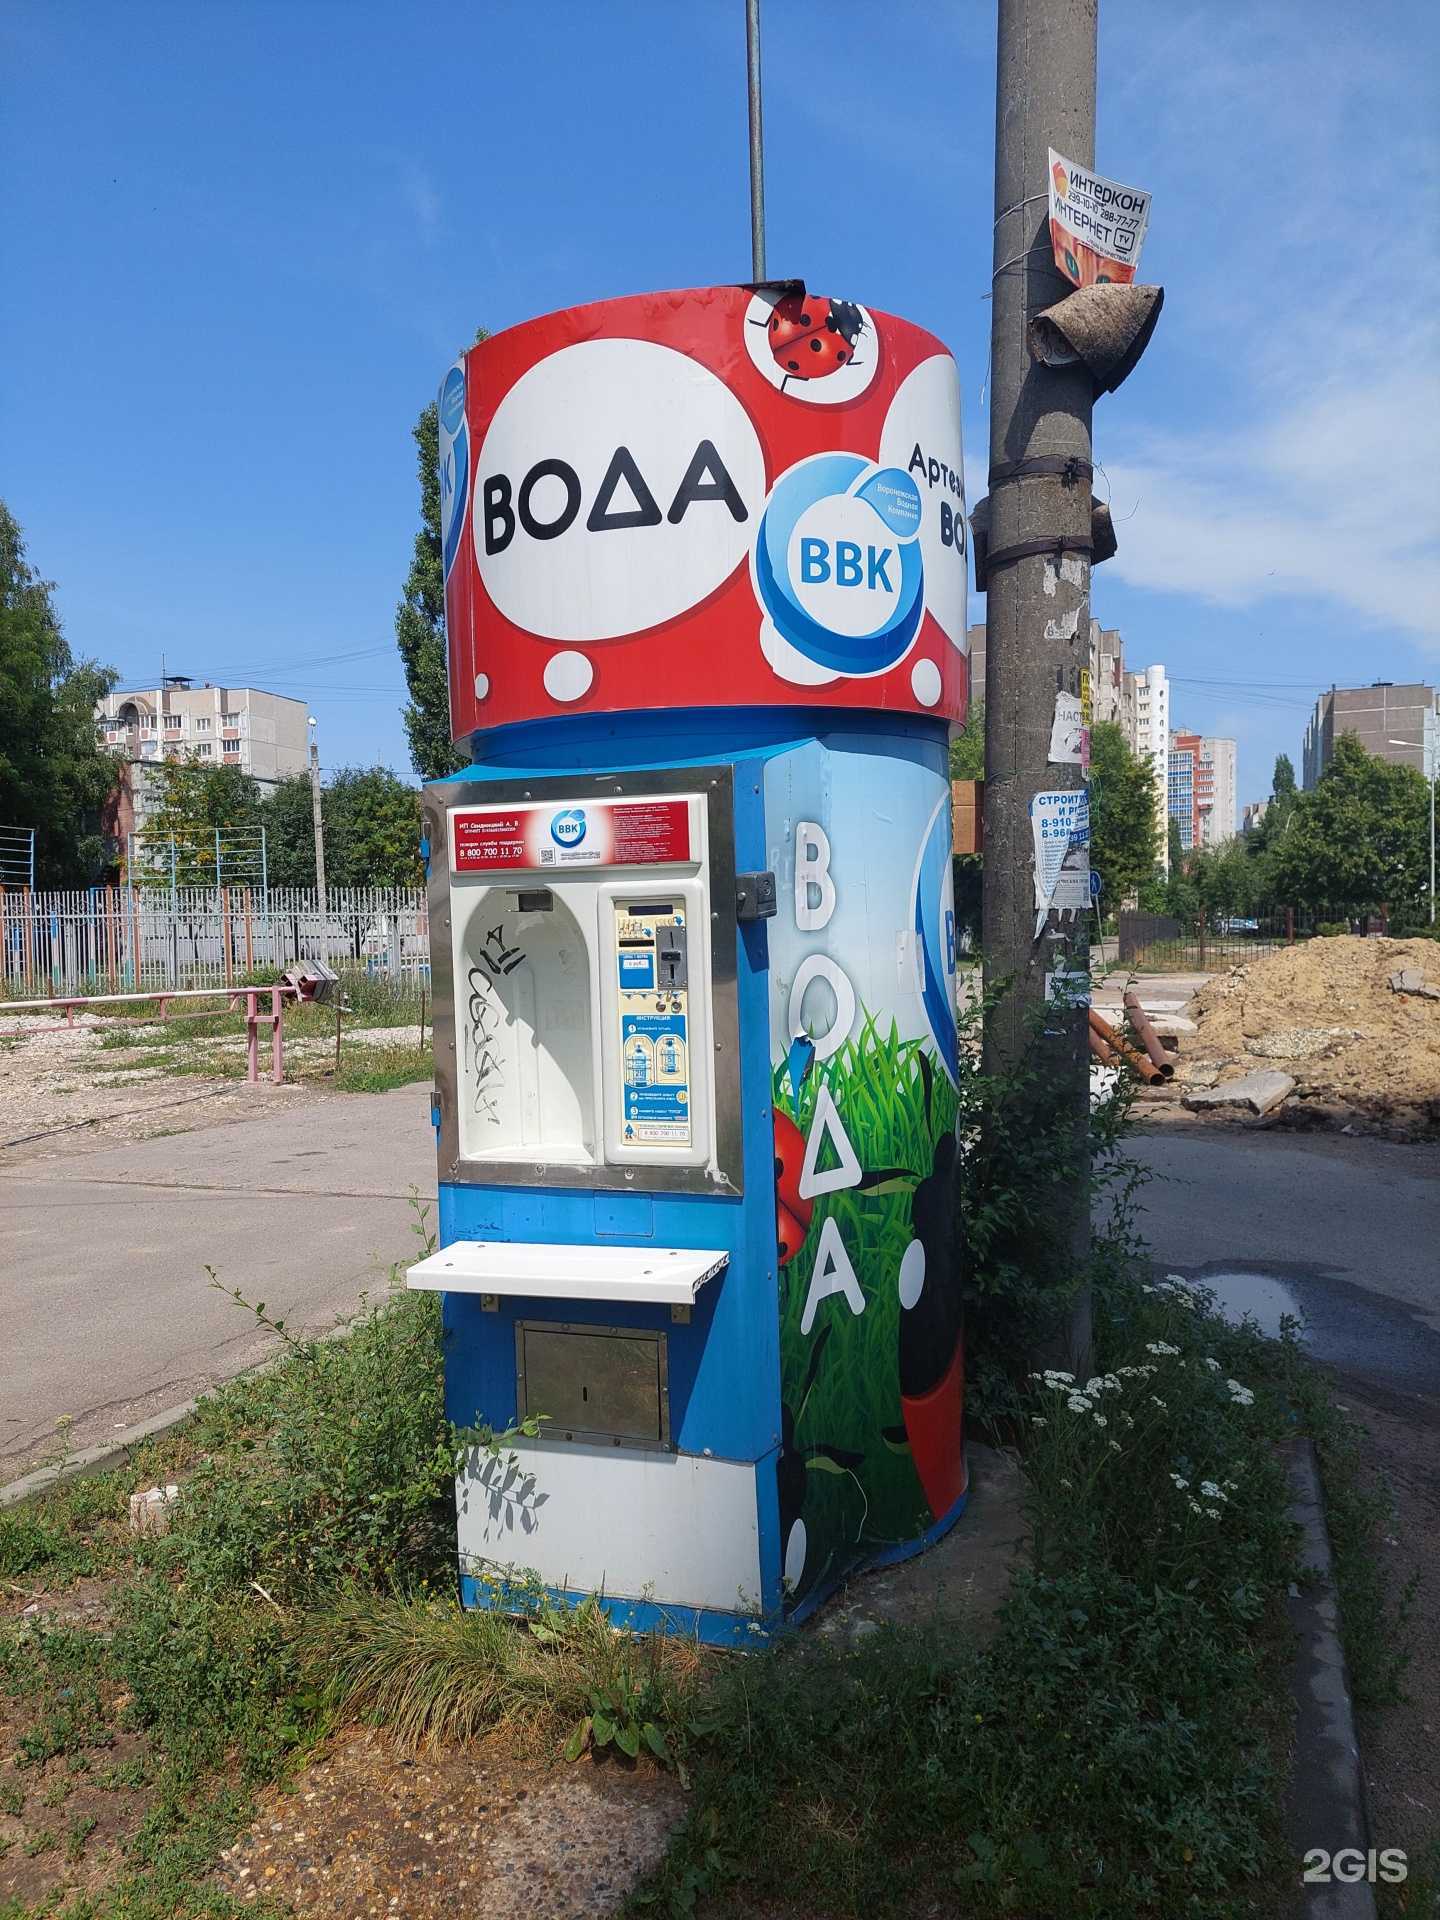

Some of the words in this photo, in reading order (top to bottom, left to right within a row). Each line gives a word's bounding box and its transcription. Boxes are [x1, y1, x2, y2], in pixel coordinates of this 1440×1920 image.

[1055, 197, 1112, 244] ИНТЕРНЕТ
[1100, 208, 1140, 230] 288-77-77
[1119, 234, 1130, 244] TV
[483, 440, 749, 556] ВОДА
[940, 501, 967, 562] ВО
[800, 537, 893, 593] ВВК
[558, 824, 579, 834] ВВК
[459, 849, 465, 857] 8
[467, 848, 481, 856] 800
[484, 847, 498, 856] 700
[500, 847, 509, 855] 11
[512, 846, 523, 855] 70
